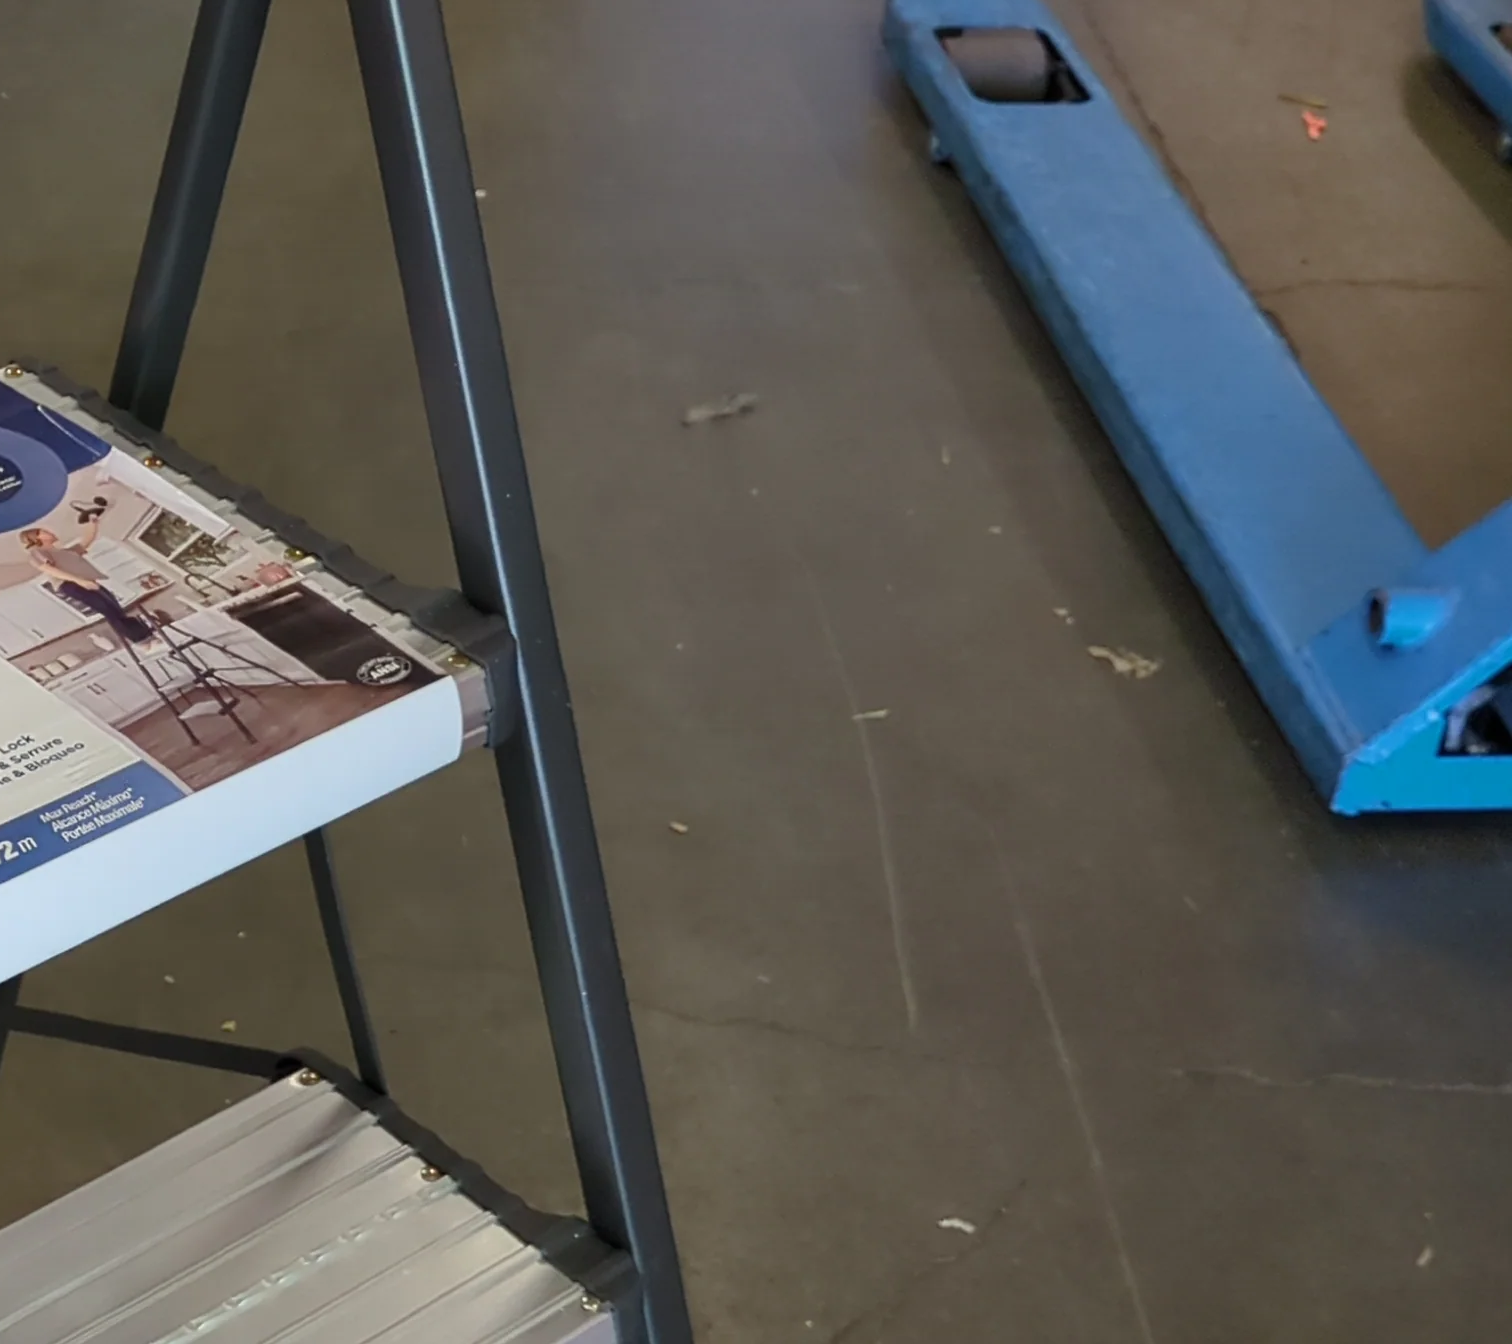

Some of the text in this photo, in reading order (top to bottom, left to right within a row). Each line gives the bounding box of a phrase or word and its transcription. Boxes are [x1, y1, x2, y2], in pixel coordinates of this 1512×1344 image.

[9, 737, 64, 765] Serrure
[12, 769, 25, 779] &
[24, 741, 86, 772] Bloqueo
[39, 808, 64, 823] Max
[51, 808, 92, 833] Alcance
[19, 835, 38, 853] m
